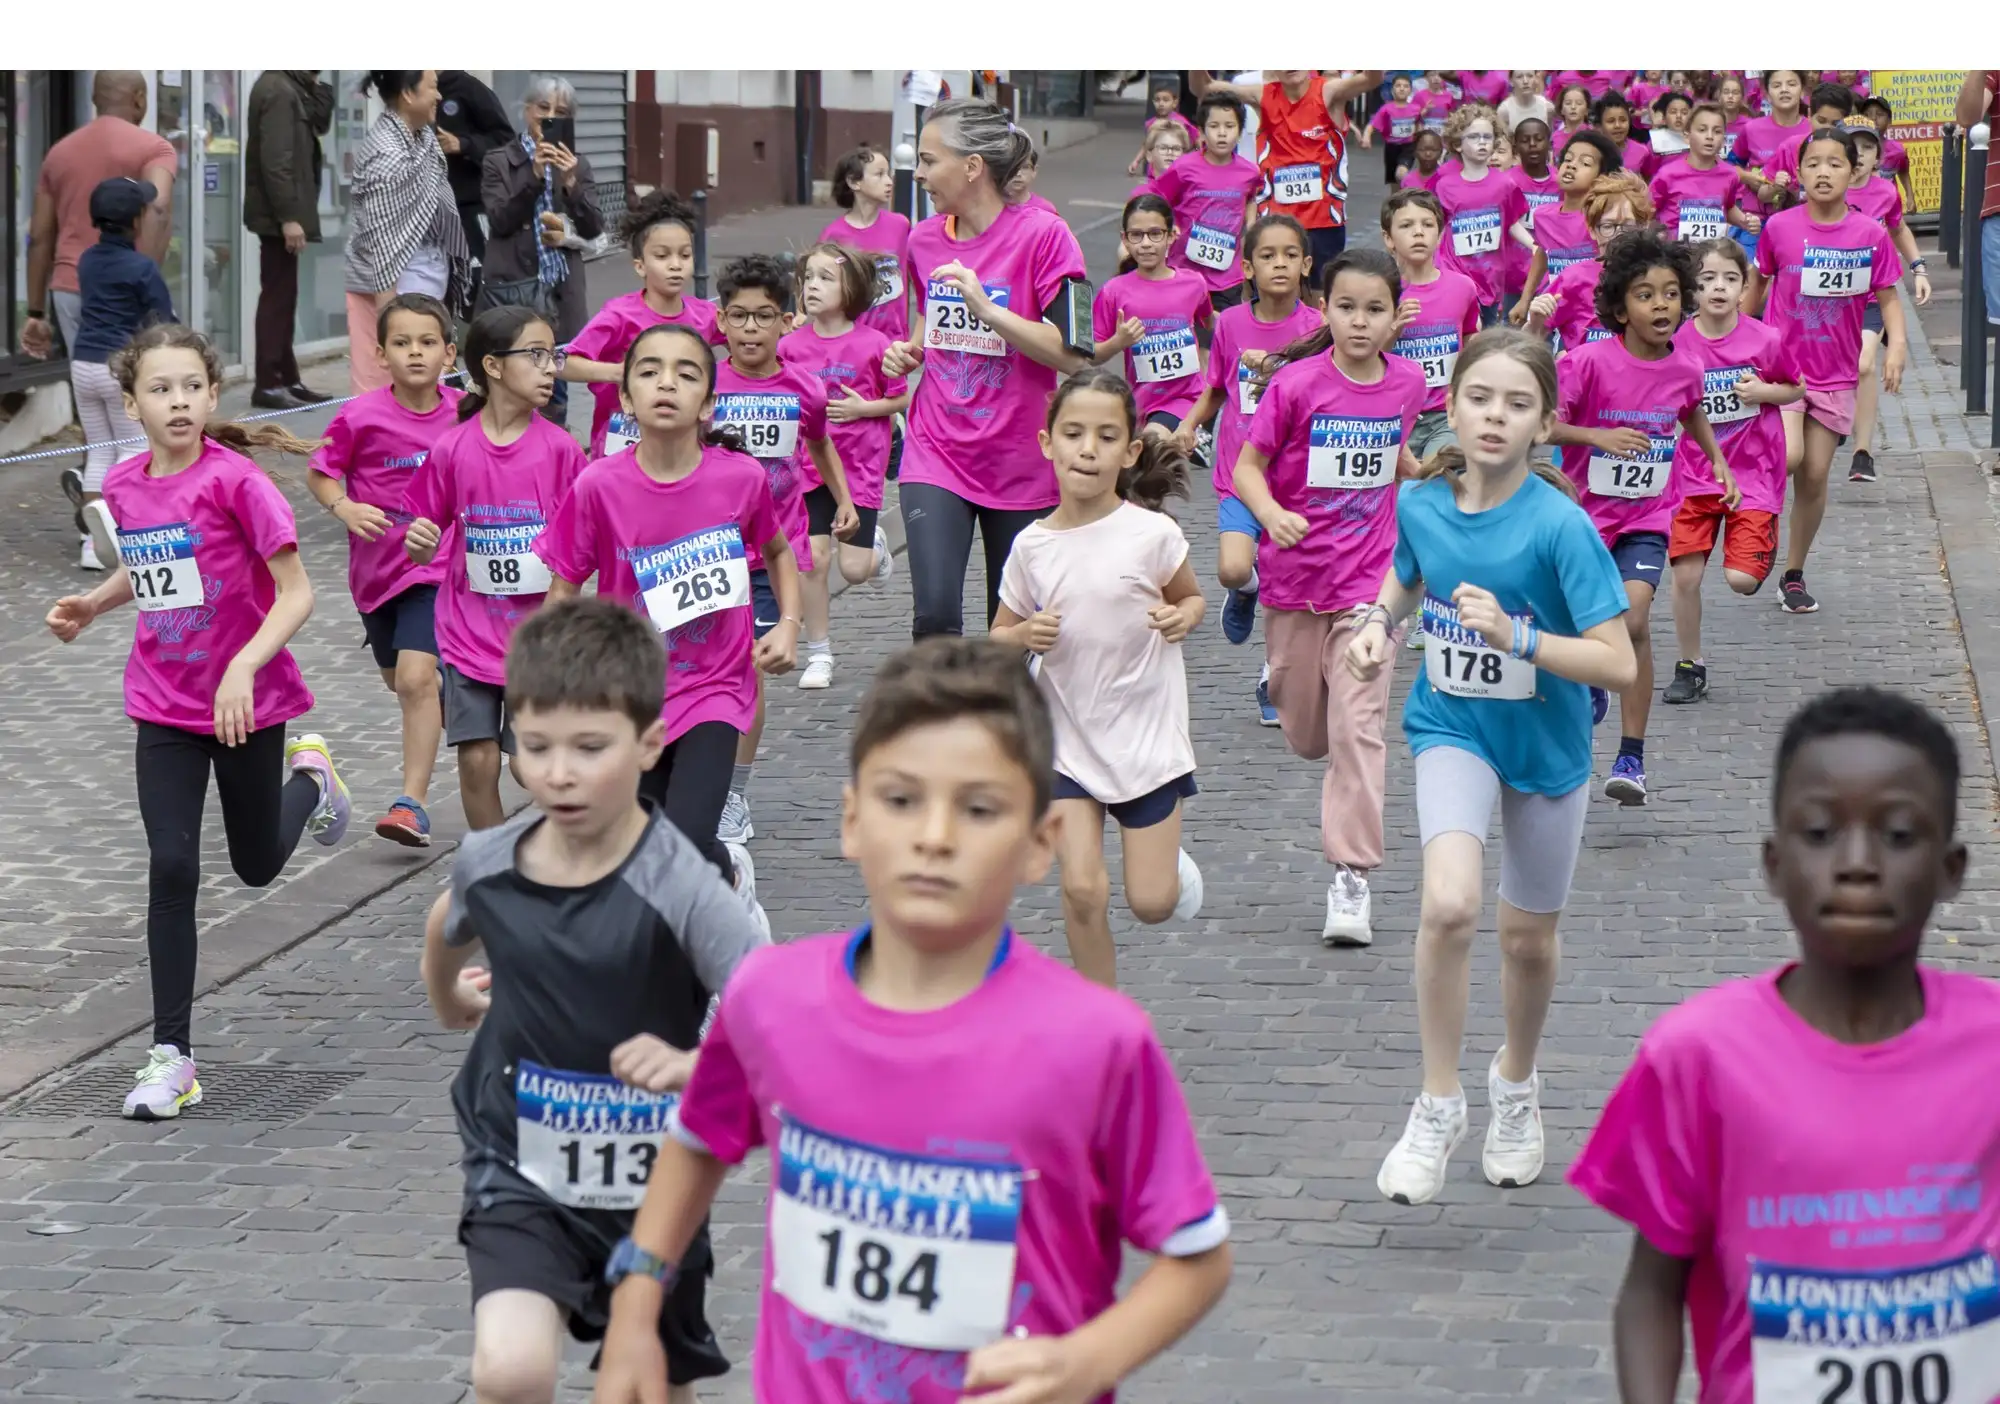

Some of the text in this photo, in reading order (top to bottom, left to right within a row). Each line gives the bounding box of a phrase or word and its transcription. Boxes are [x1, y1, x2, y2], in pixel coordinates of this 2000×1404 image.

[1884, 126, 1933, 140] ERVICE
[1285, 182, 1311, 198] 934
[1465, 231, 1493, 248] 174
[1691, 224, 1717, 238] 215
[1197, 244, 1224, 263] 333
[1818, 271, 1853, 289] 241
[1148, 352, 1184, 374] 143
[1701, 393, 1740, 415] 583
[1313, 418, 1401, 433] LA FONTENAISIENNE
[1335, 452, 1383, 478] 195
[1611, 464, 1655, 489] 124
[634, 527, 740, 574] LA FONTENAISIENNE
[130, 567, 178, 599] 212
[488, 559, 521, 584] 88
[672, 567, 731, 611] 263
[1440, 646, 1503, 685] 178
[1449, 684, 1489, 695] MARGAUX
[519, 1071, 541, 1096] LA
[559, 1141, 658, 1187] 113
[817, 1228, 939, 1314] 184
[1816, 1352, 1951, 1404] 200
